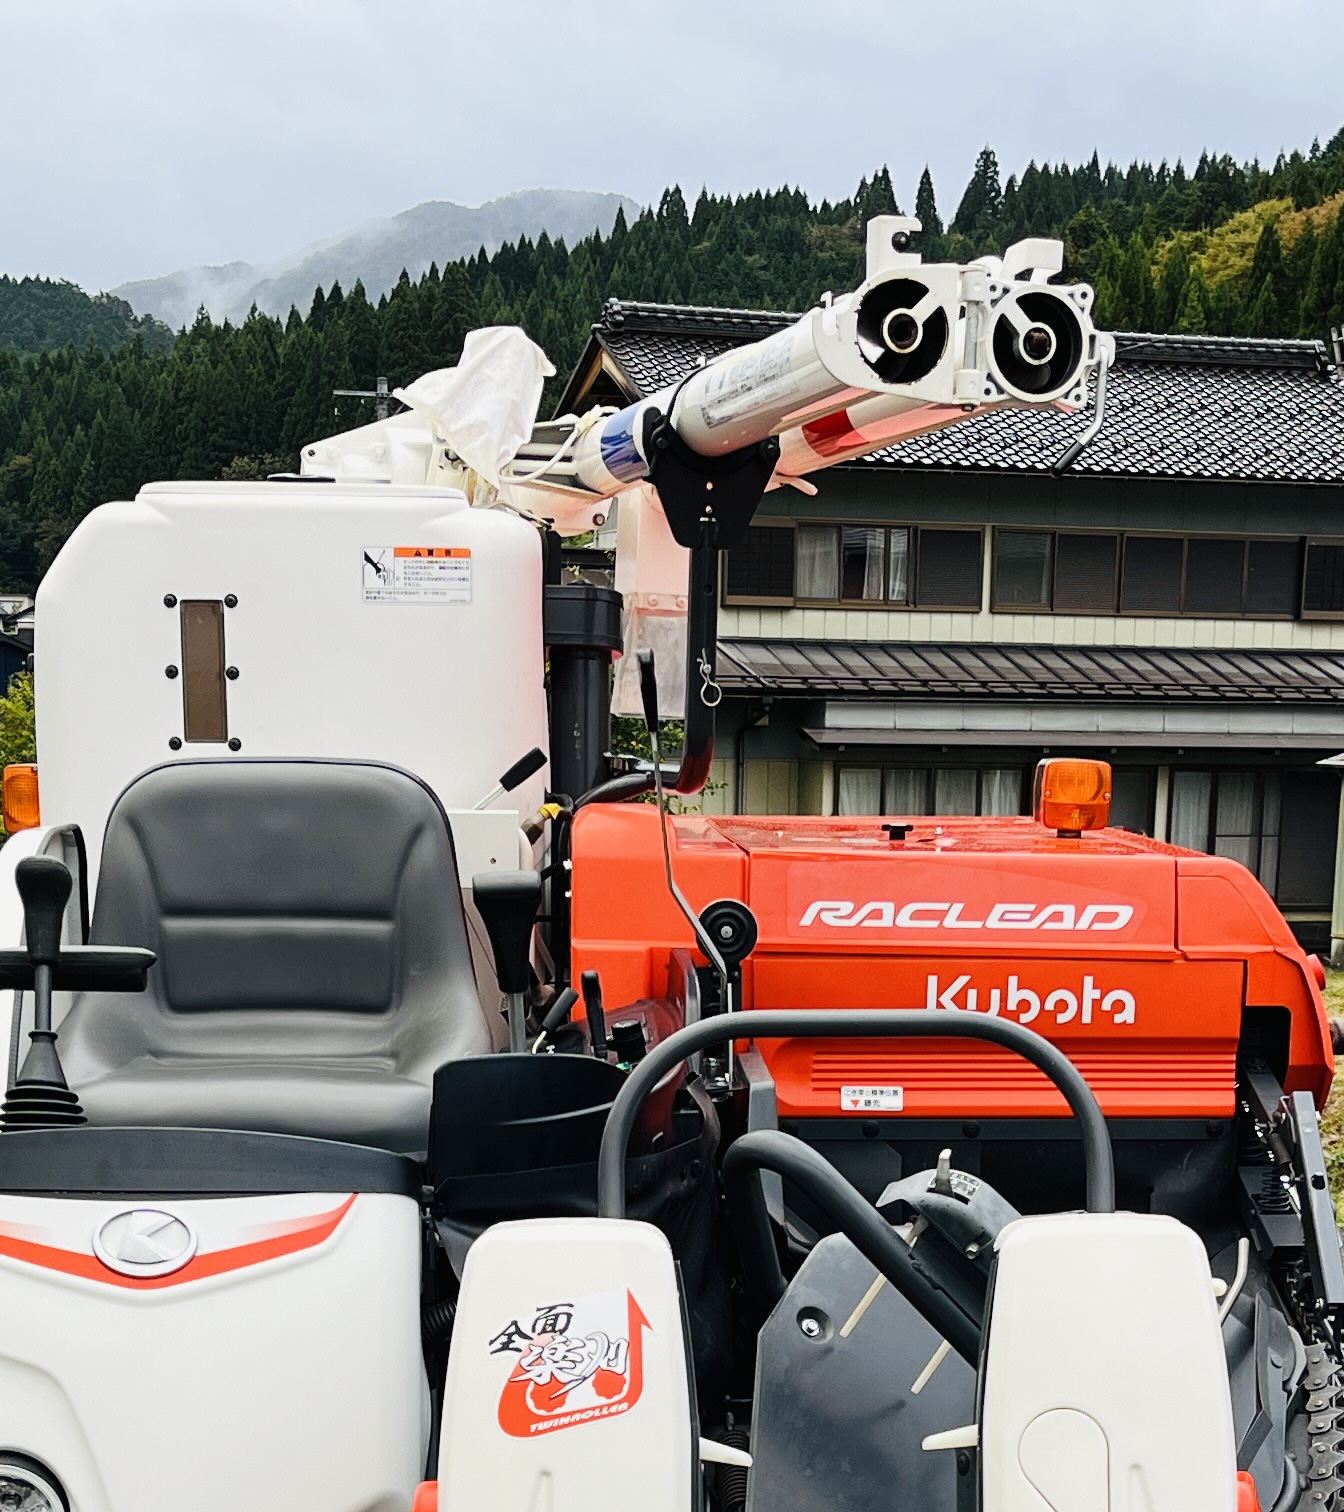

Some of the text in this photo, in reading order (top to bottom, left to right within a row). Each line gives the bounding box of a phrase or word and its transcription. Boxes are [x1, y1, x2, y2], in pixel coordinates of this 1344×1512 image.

[799, 900, 1135, 931] RACLEAD
[925, 974, 1137, 1026] Kubota
[529, 1402, 630, 1433] TWINROLLER
